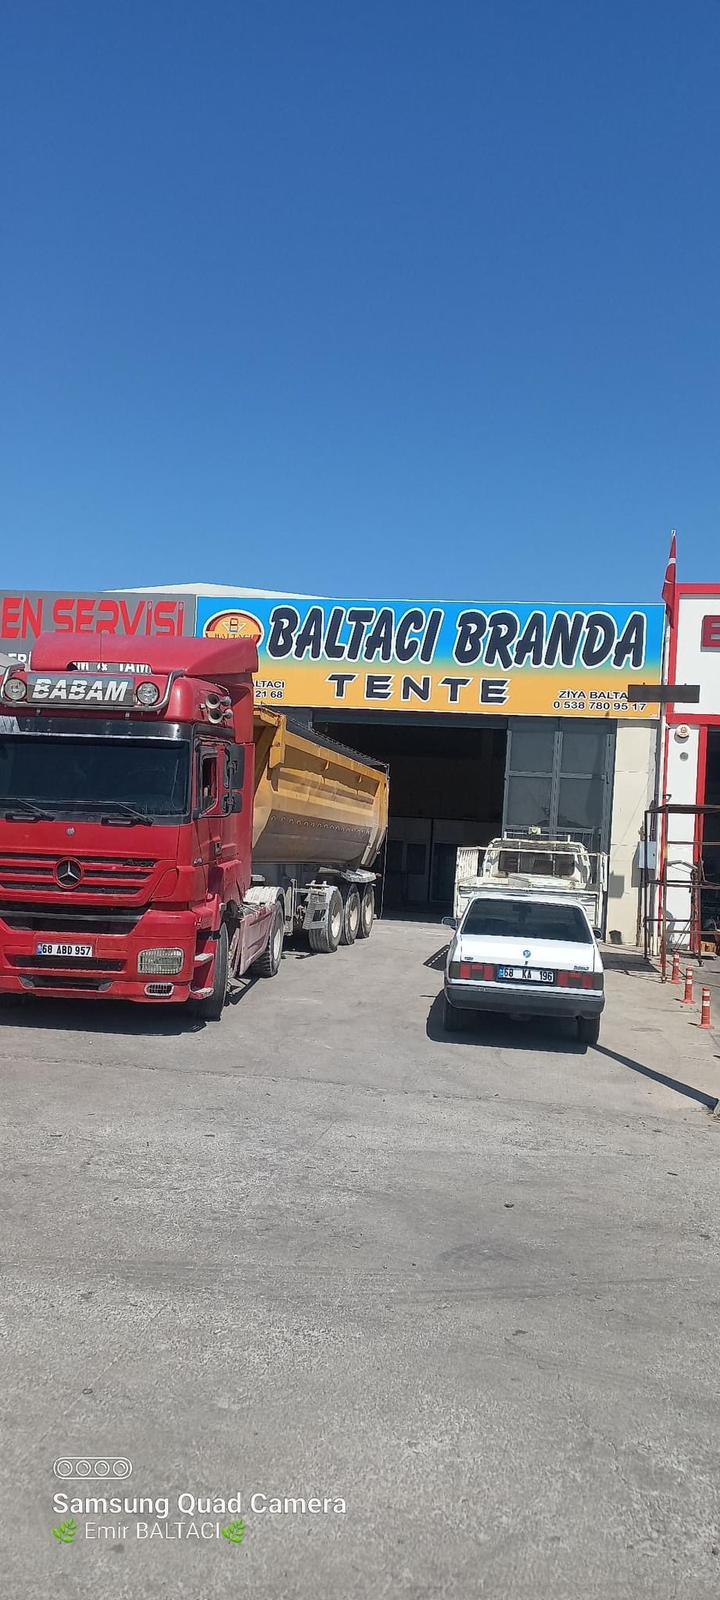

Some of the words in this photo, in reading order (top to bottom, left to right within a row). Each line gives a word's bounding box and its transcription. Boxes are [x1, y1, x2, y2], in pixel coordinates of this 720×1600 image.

[267, 606, 444, 663] BALTACI
[454, 610, 645, 669] BRANDA
[32, 678, 128, 702] BABAM
[252, 680, 285, 689] LTACI
[327, 673, 511, 705] TENTE
[270, 690, 283, 699] 68
[589, 691, 628, 700] BALTA
[553, 701, 560, 709] 0
[564, 701, 585, 709] 538
[589, 702, 610, 710] 780
[613, 702, 628, 711] 95
[632, 703, 646, 711] 17
[42, 944, 53, 954] 68
[56, 945, 73, 955] ABD
[75, 945, 91, 956] 957
[504, 967, 514, 978] 68
[521, 969, 532, 979] KA
[540, 971, 553, 982] 196
